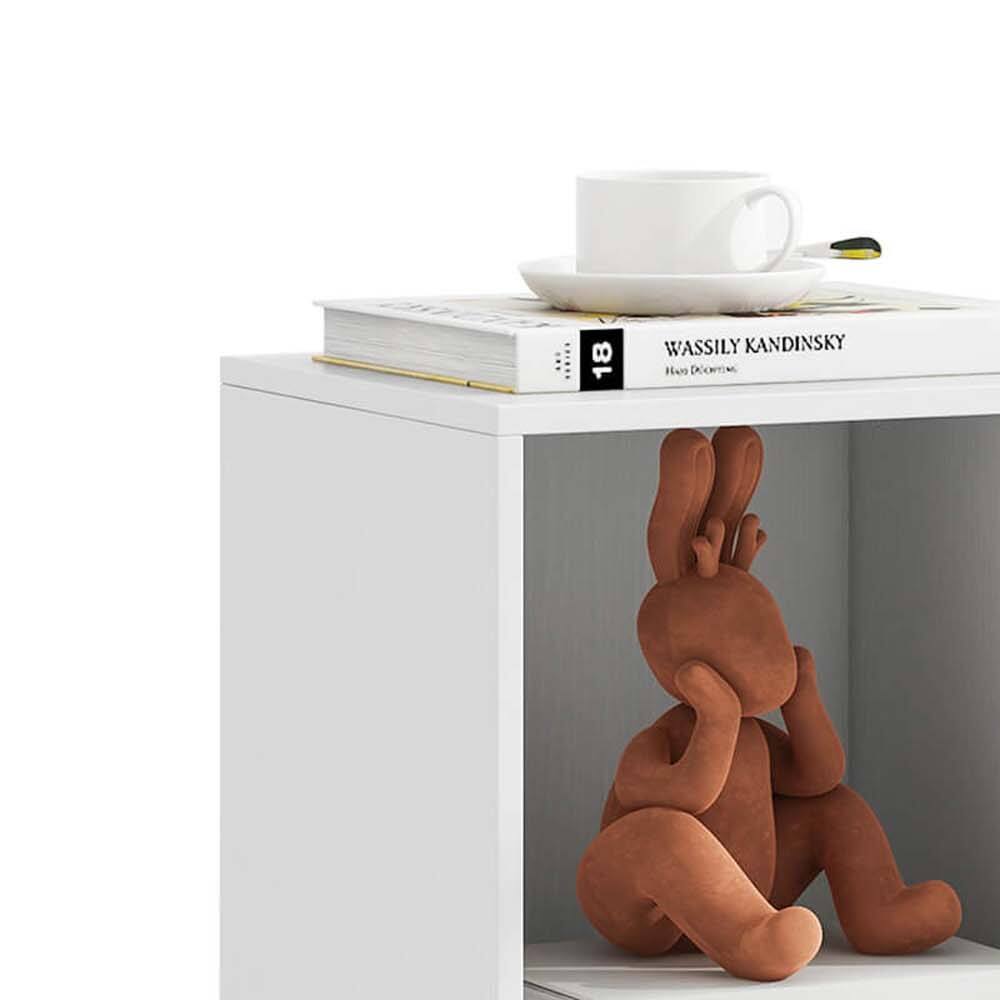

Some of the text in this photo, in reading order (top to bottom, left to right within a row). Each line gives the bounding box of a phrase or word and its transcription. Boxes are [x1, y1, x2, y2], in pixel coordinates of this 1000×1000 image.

[592, 341, 613, 380] 18
[664, 333, 846, 357] WASSILY KANDINSKY
